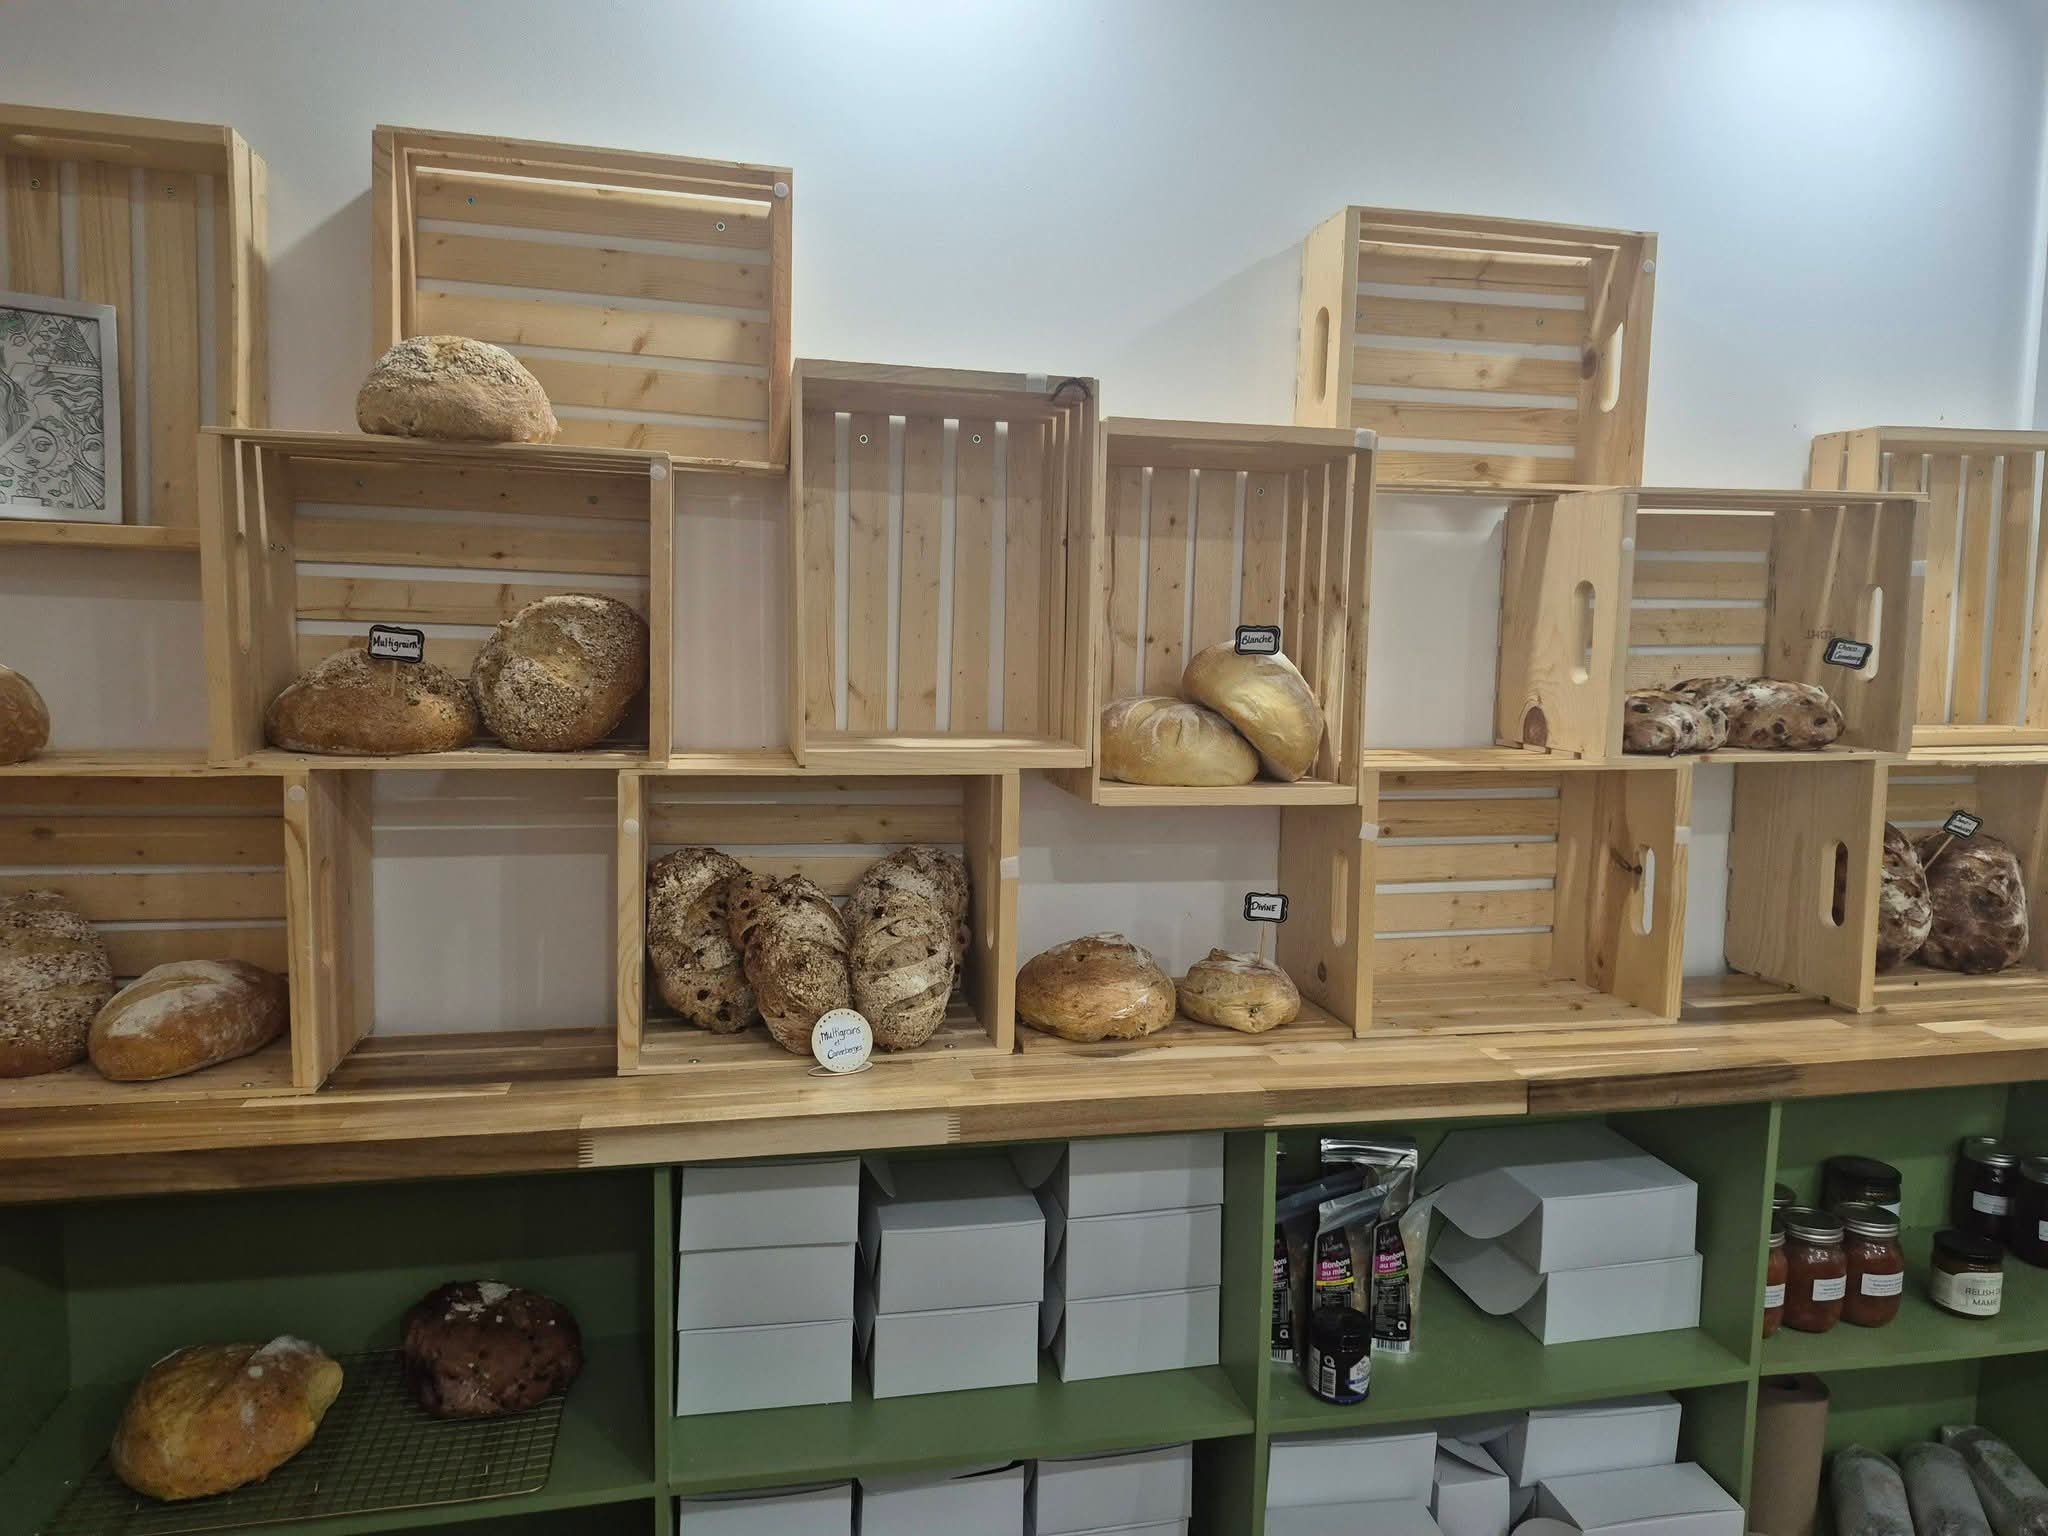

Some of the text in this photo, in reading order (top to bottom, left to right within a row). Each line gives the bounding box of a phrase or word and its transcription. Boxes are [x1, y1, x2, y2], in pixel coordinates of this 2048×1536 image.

[1241, 634, 1273, 645] Blanche
[1380, 1251, 1404, 1262] Bonbons
[1322, 1259, 1350, 1269] Bonbons
[1389, 1258, 1402, 1267] miel
[1332, 1266, 1346, 1275] miel
